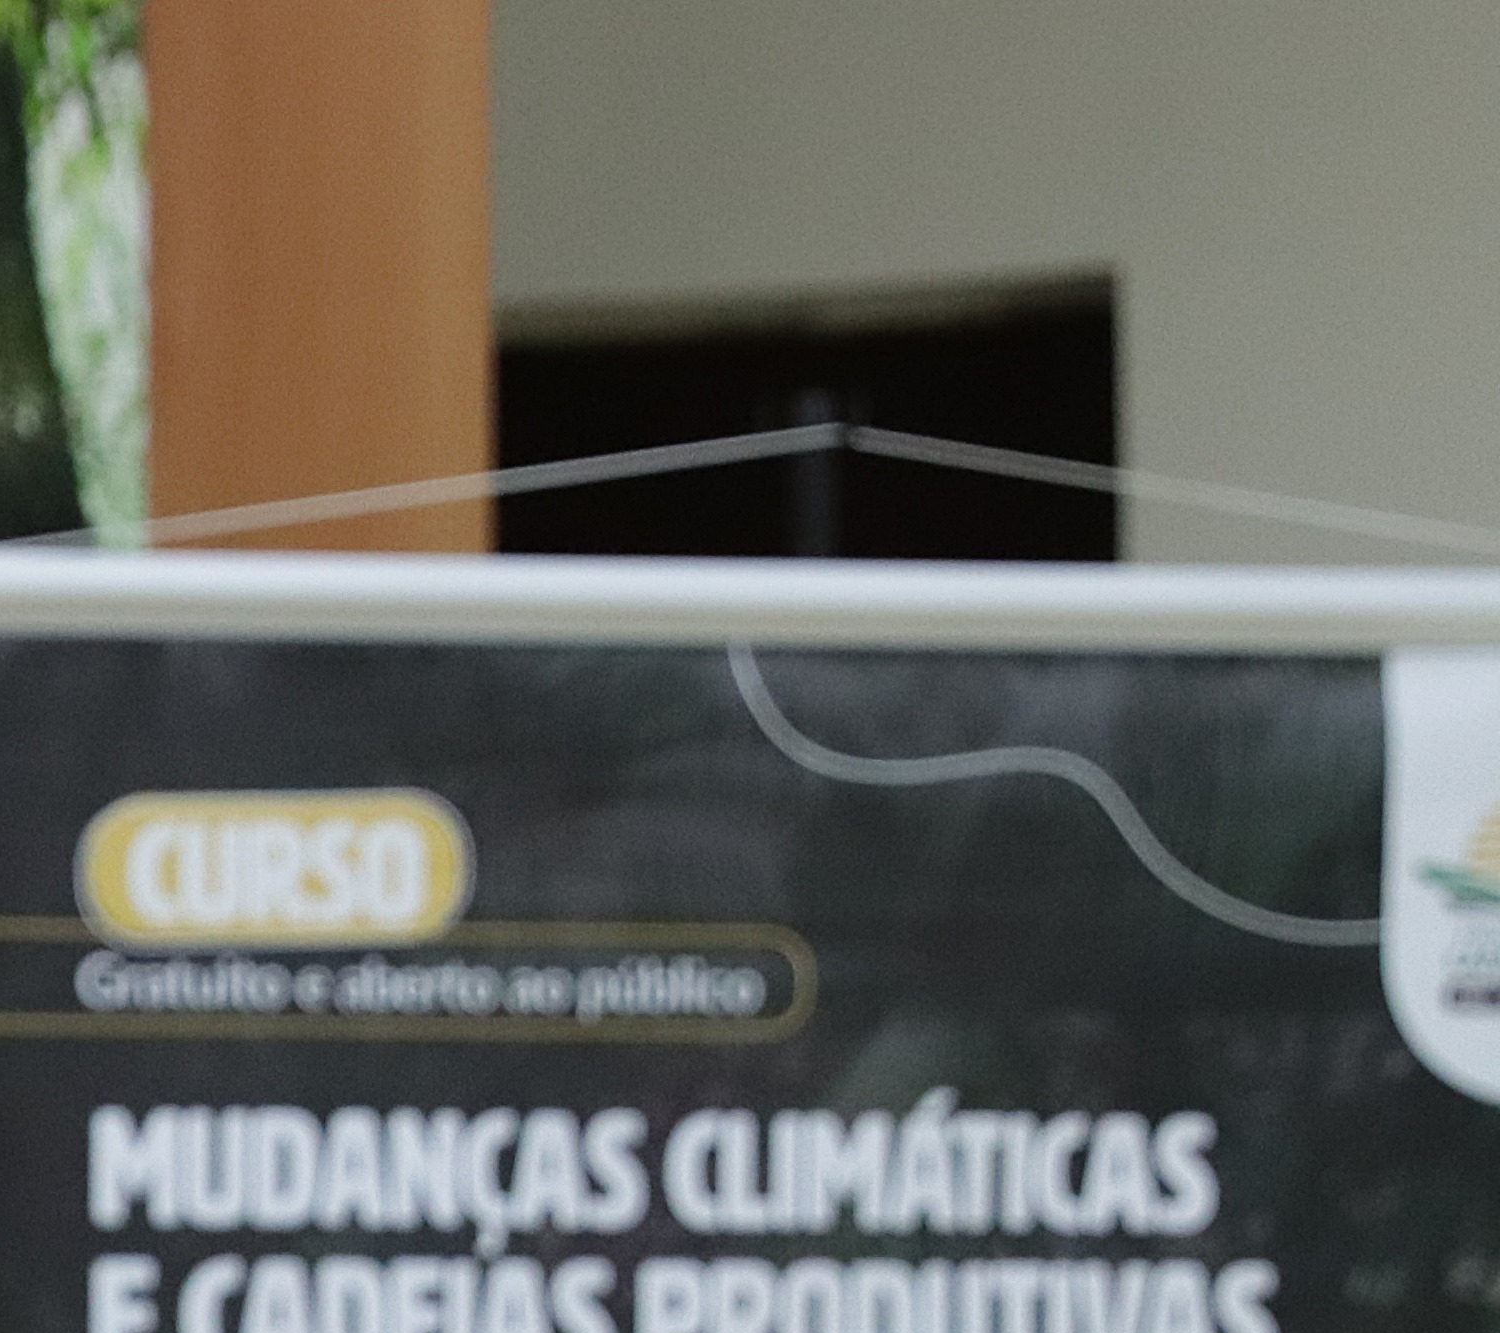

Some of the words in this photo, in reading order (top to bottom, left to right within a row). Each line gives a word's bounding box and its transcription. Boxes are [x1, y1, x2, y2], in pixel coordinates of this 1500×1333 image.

[123, 812, 428, 929] CURSO
[76, 952, 290, 1010] Gratuito
[297, 967, 334, 1010] e
[338, 957, 501, 1012] aberto
[506, 967, 572, 1012] ao
[577, 955, 766, 1024] público
[88, 1102, 648, 1257] MUDANÇAS
[664, 1087, 1219, 1237] CLIMÁTICAS
